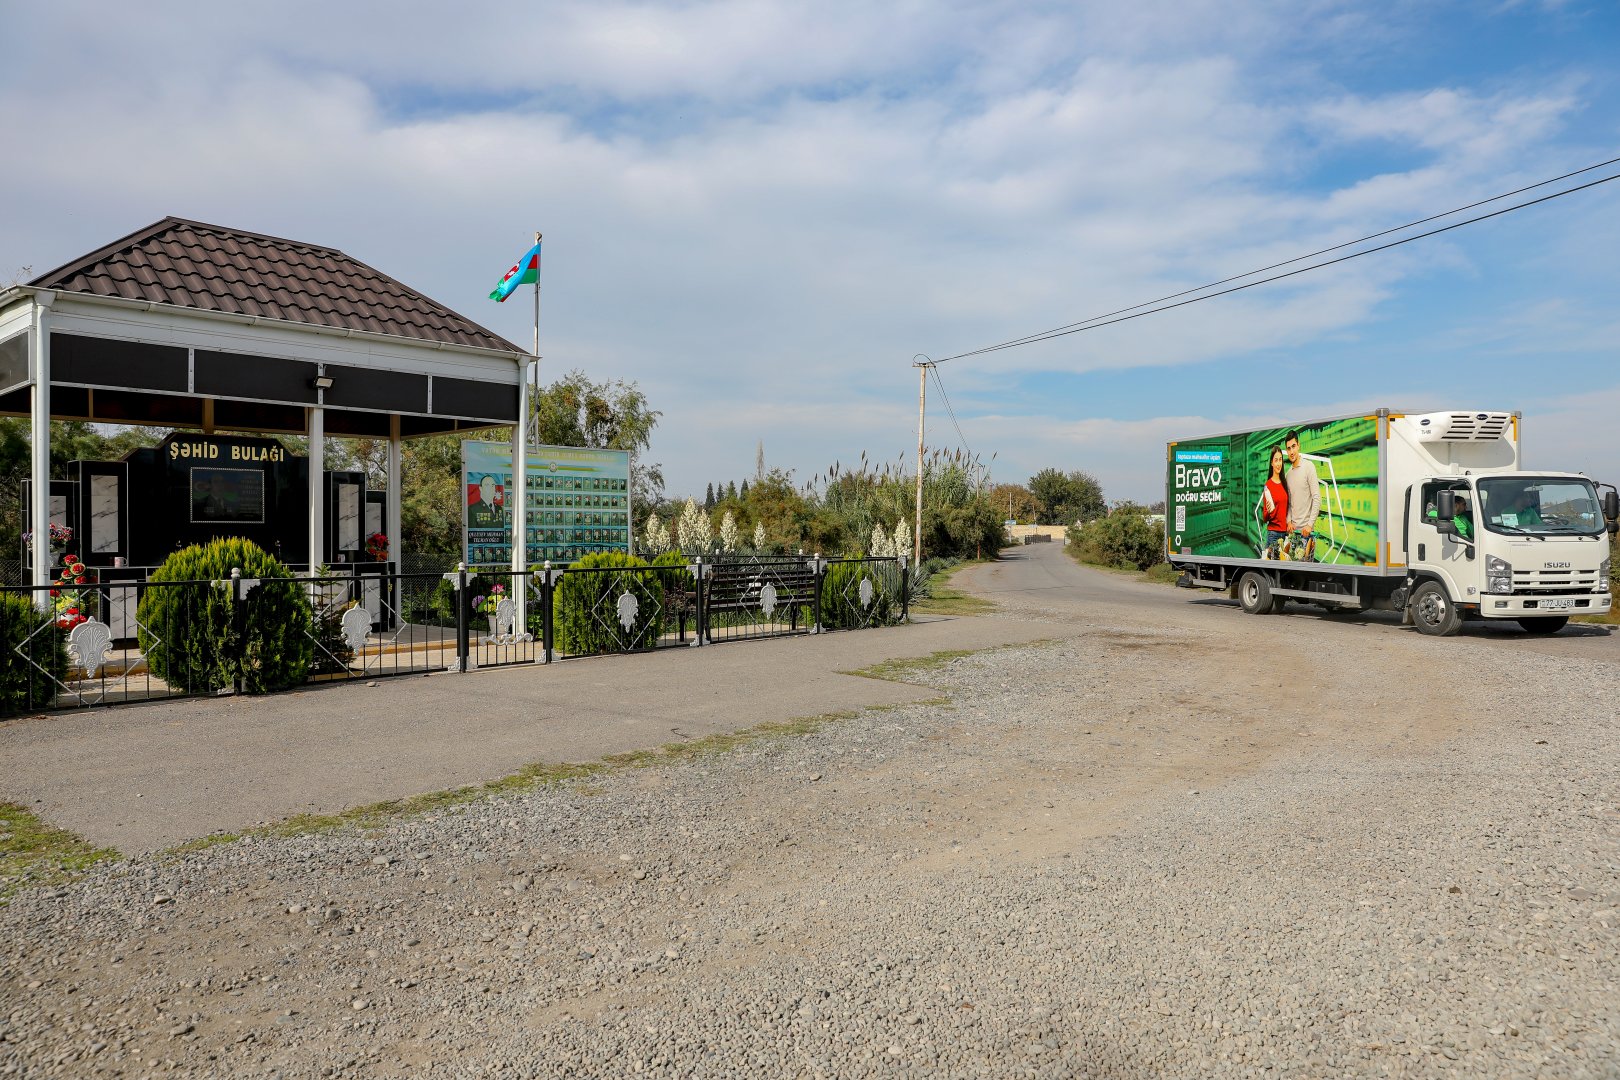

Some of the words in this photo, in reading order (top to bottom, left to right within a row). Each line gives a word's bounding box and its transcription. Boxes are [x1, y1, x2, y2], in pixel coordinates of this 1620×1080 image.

[170, 442, 218, 460] ŞƏHİD
[231, 445, 284, 462] BULAĞI
[1176, 464, 1222, 488] Bravo
[1176, 491, 1198, 502] DOĞRU
[1200, 490, 1221, 504] SEÇİM
